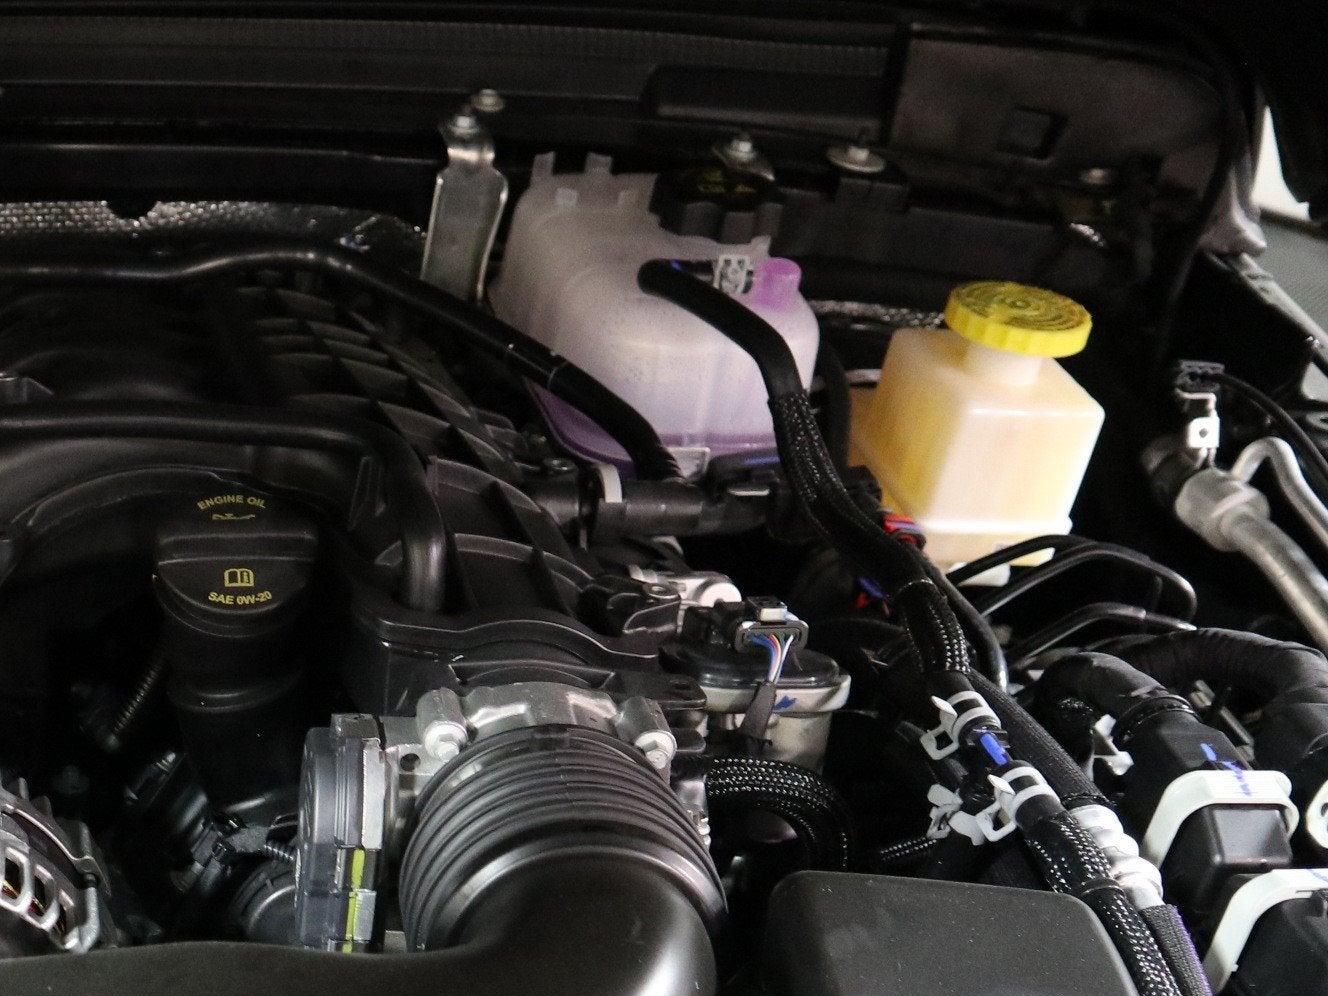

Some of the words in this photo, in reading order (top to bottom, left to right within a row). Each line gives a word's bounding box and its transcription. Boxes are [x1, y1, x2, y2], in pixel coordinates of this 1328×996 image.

[197, 495, 243, 510] ENGINE
[247, 497, 265, 508] OIL
[208, 591, 234, 605] SAE
[236, 591, 272, 605] 0W-20
